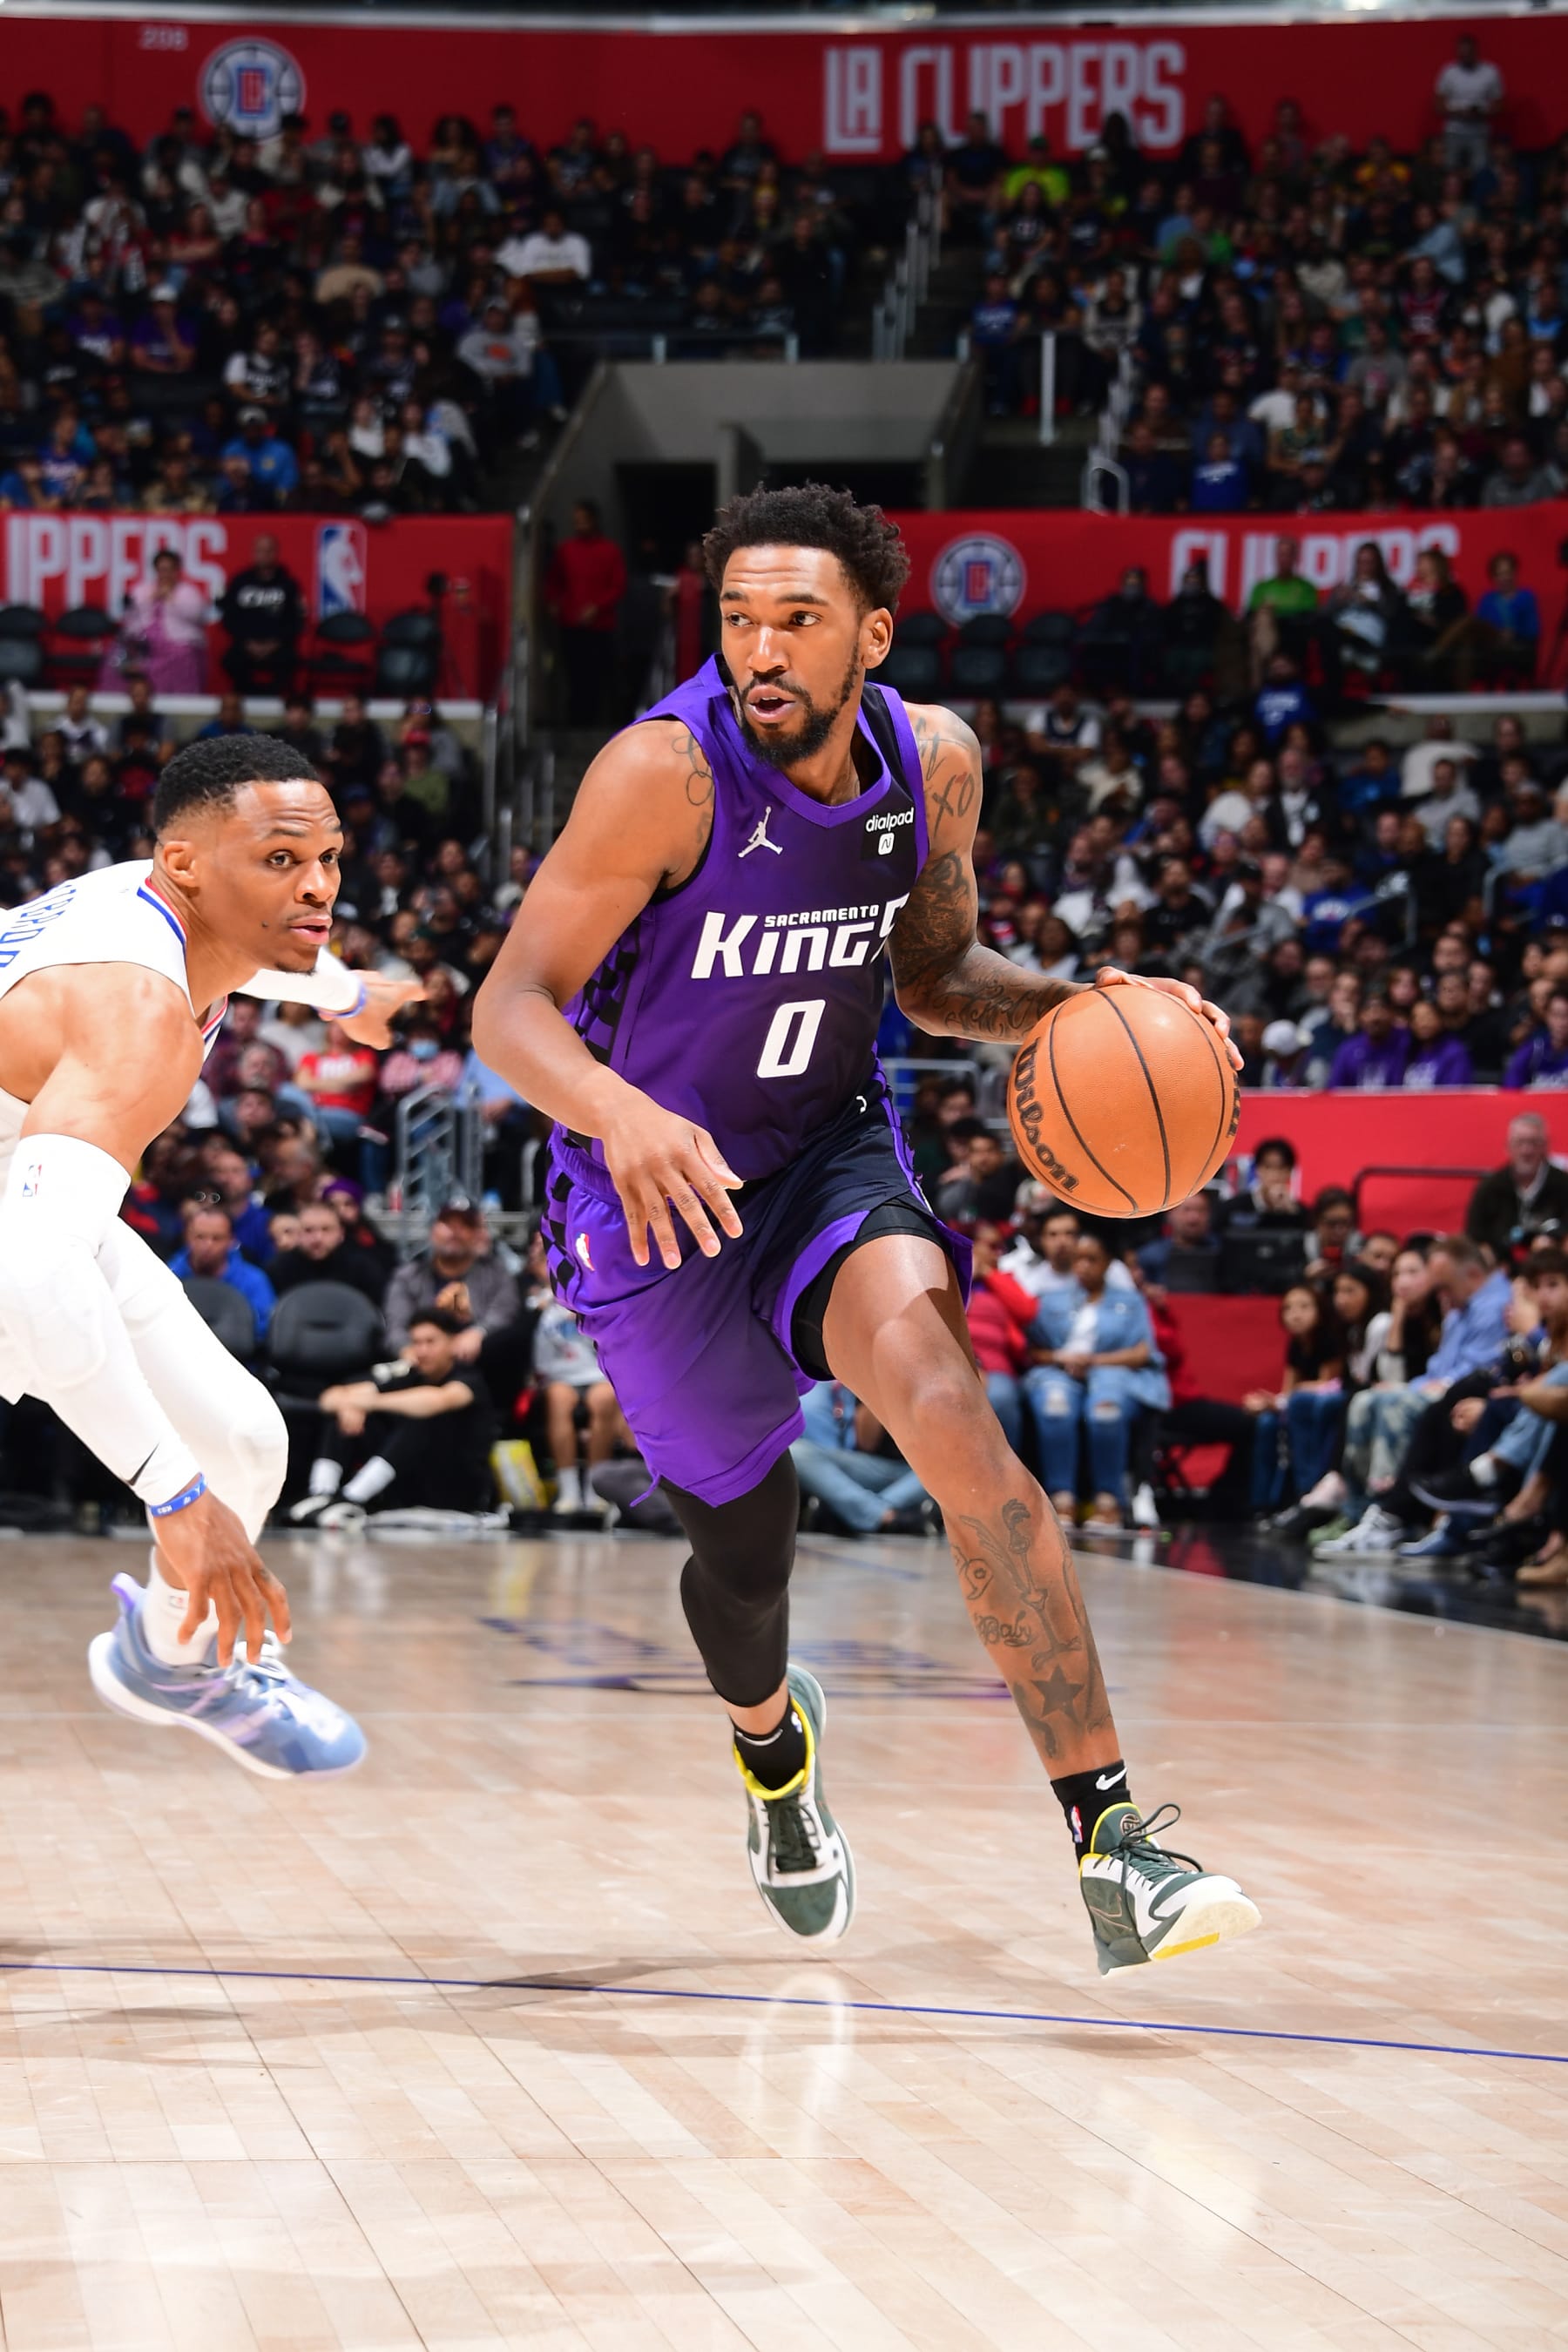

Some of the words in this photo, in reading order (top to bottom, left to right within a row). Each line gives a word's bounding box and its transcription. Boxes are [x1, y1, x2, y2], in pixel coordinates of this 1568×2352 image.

[825, 46, 882, 153] LA
[899, 41, 1185, 149] CLIPPERS
[865, 808, 915, 832] dialpad
[764, 904, 879, 928] SACRAMENTO
[756, 999, 826, 1078] 0
[1014, 1037, 1079, 1193] Wilson
